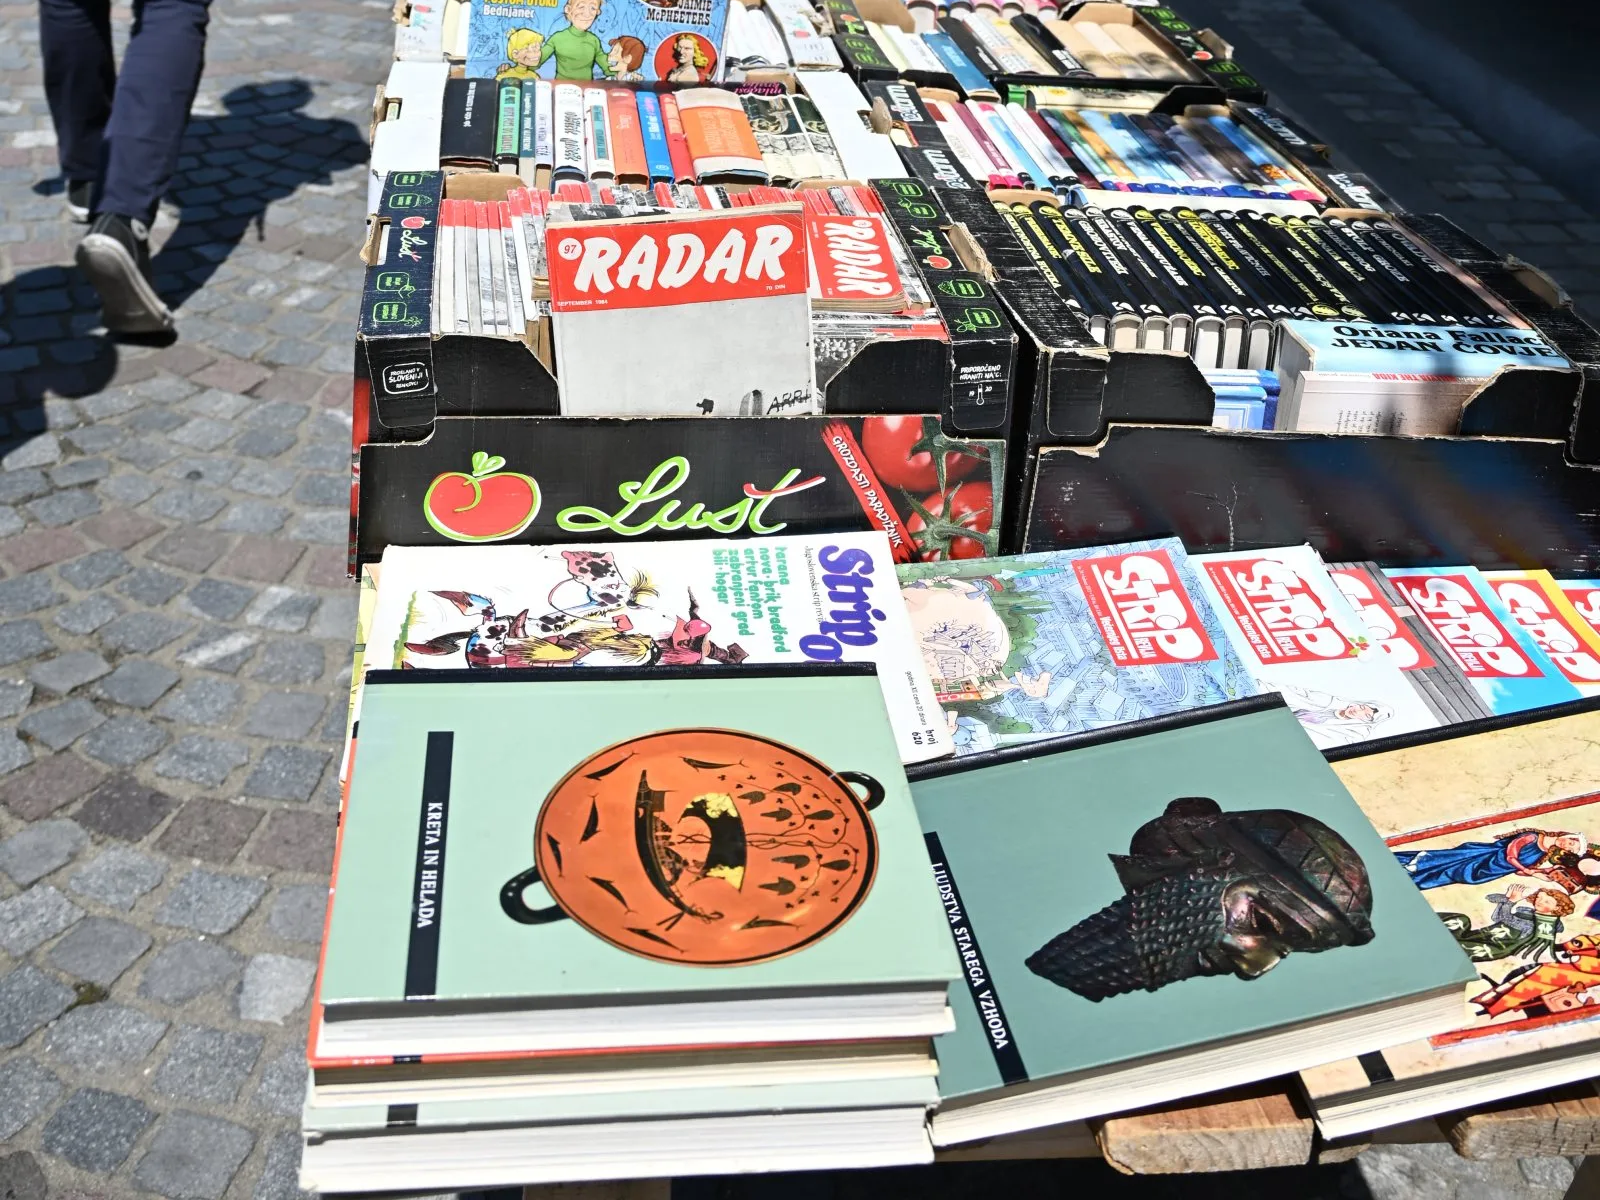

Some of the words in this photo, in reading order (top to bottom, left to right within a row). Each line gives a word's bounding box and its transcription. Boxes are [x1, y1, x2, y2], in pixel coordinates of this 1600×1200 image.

[483, 5, 535, 18] Bednjanec
[646, 8, 710, 26] McPHEETERS
[563, 244, 577, 254] 97
[573, 224, 794, 294] RADAR
[823, 222, 893, 296] RADAR
[1330, 337, 1446, 354] JEDAN
[1452, 340, 1560, 359] ČOVJE
[1333, 324, 1443, 342] Oriana
[1445, 327, 1544, 348] Fallac
[388, 372, 423, 383] SLOVENIJI
[984, 371, 994, 379] NA
[556, 455, 826, 536] Lust
[832, 435, 872, 493] GROZDASTI
[864, 490, 904, 549] PARADIŽNIK
[743, 547, 756, 577] artur
[758, 547, 770, 575] nova
[711, 571, 729, 605] hogar
[728, 548, 747, 609] zabranjeni
[763, 578, 778, 606] brik
[748, 578, 764, 619] fantom
[818, 545, 887, 648] Strip
[731, 611, 755, 636] grad
[767, 605, 792, 653] bradford
[925, 729, 939, 745] broj
[424, 802, 443, 845] KRETA
[422, 849, 439, 865] IN
[416, 870, 438, 929] HELADA
[931, 862, 963, 924] LJUDSTVA
[954, 926, 986, 988] STAREGA
[978, 989, 1009, 1050] VZHODA
